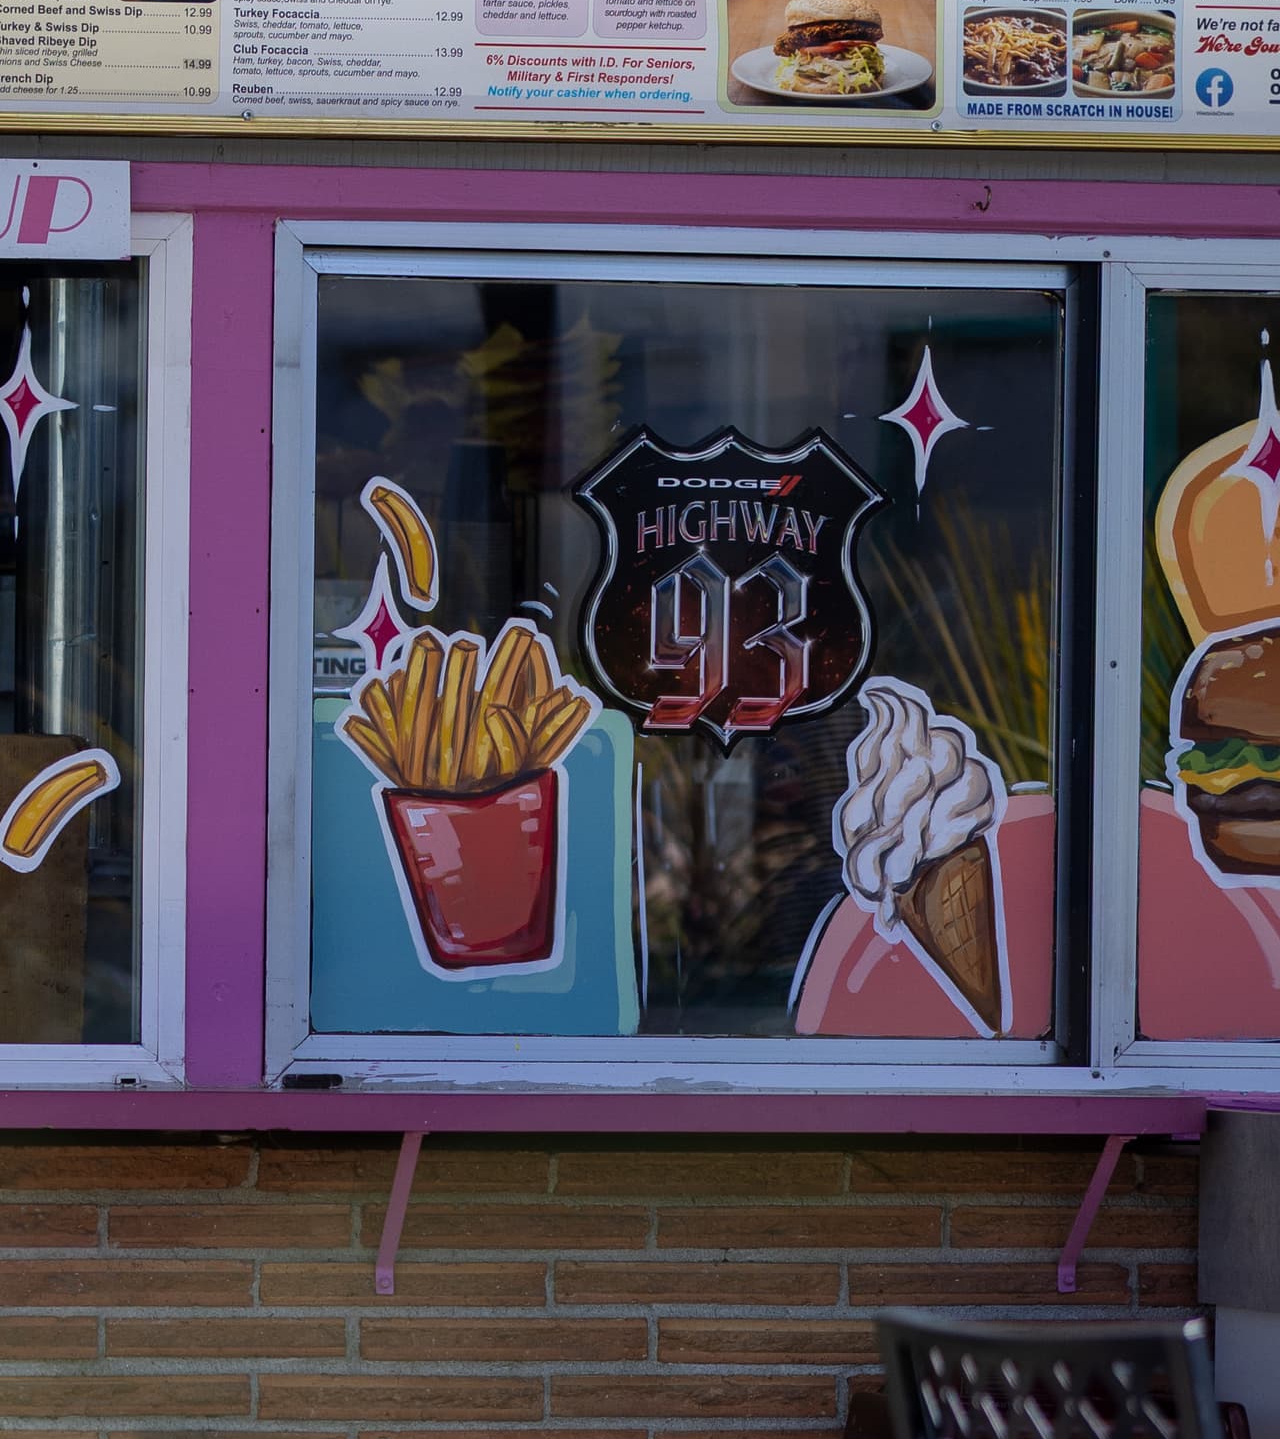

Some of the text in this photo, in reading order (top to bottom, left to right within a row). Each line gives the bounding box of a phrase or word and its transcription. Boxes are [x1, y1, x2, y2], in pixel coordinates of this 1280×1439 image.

[967, 103, 1173, 118] MADE FROM SCRATCH IN HOUSE!
[657, 477, 782, 490] DODGE
[637, 500, 828, 554] HIGHWAY
[642, 551, 811, 731] 93
